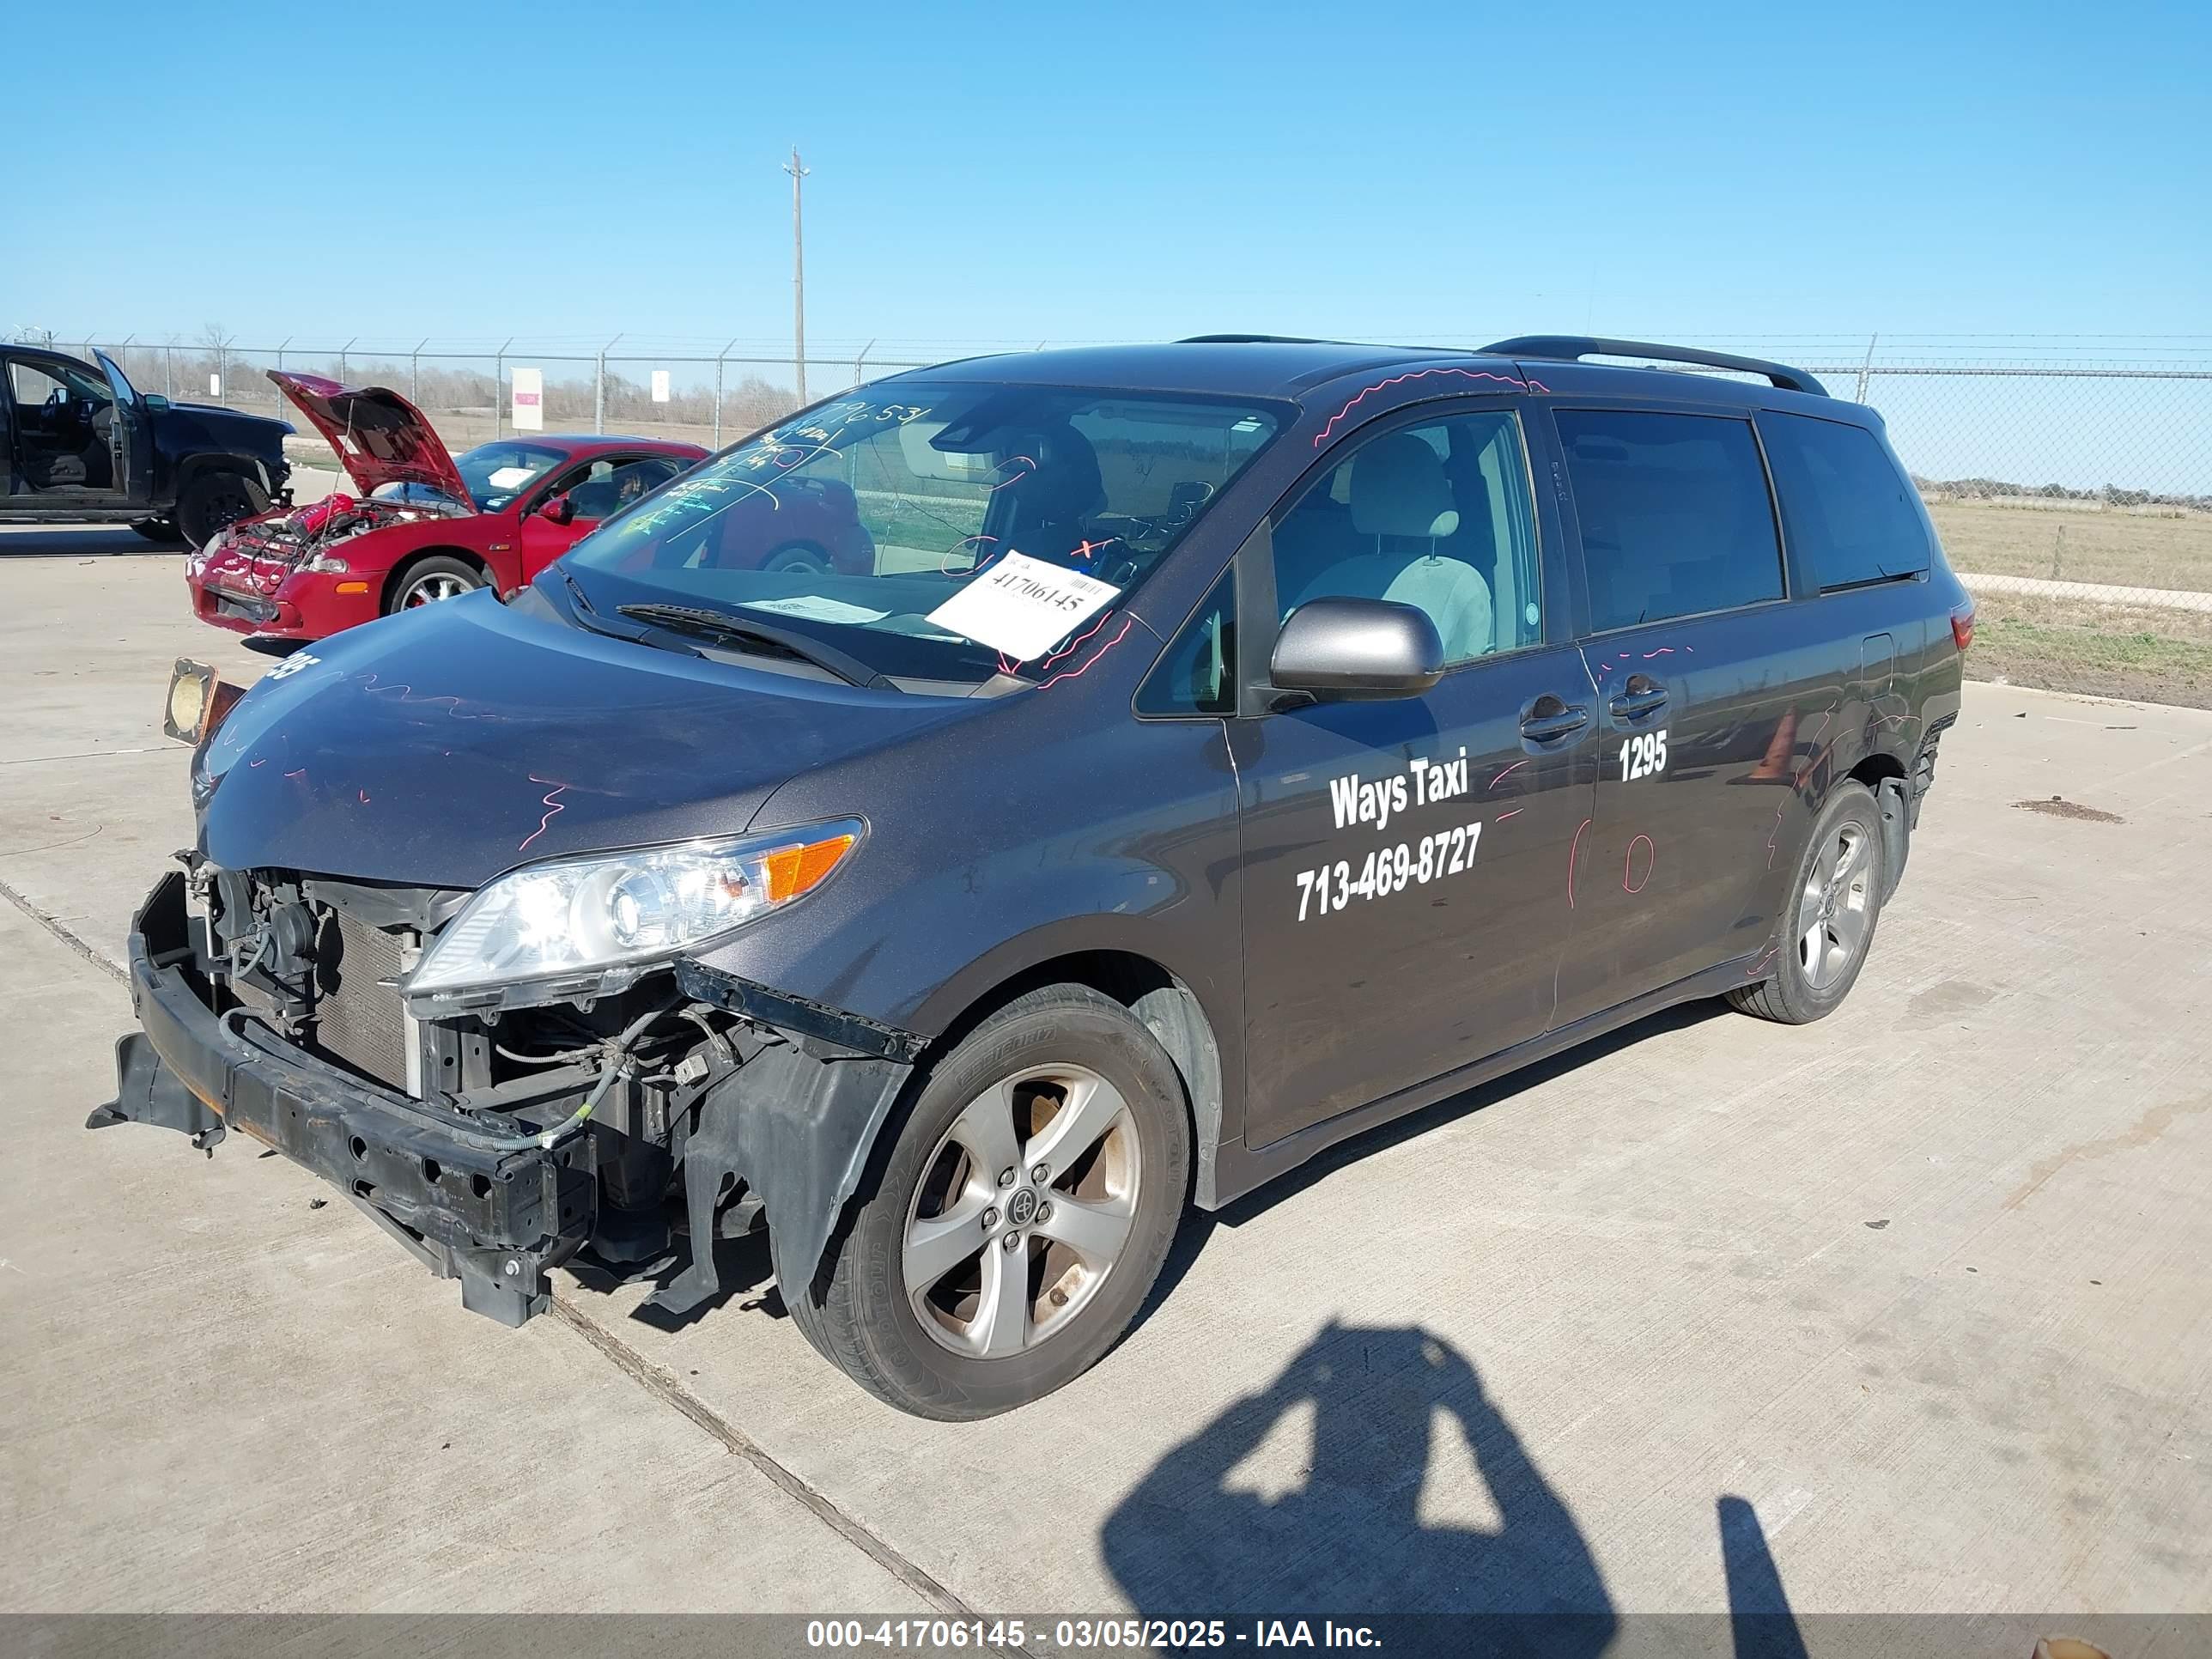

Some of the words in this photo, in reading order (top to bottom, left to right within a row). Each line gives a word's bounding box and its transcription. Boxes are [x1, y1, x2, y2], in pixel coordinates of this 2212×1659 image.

[992, 572, 1085, 611] 41706145
[1329, 773, 1408, 831] Ways
[1410, 745, 1468, 806] Taxi
[1619, 730, 1668, 782] 1295
[1296, 822, 1482, 922] 713-469-8727
